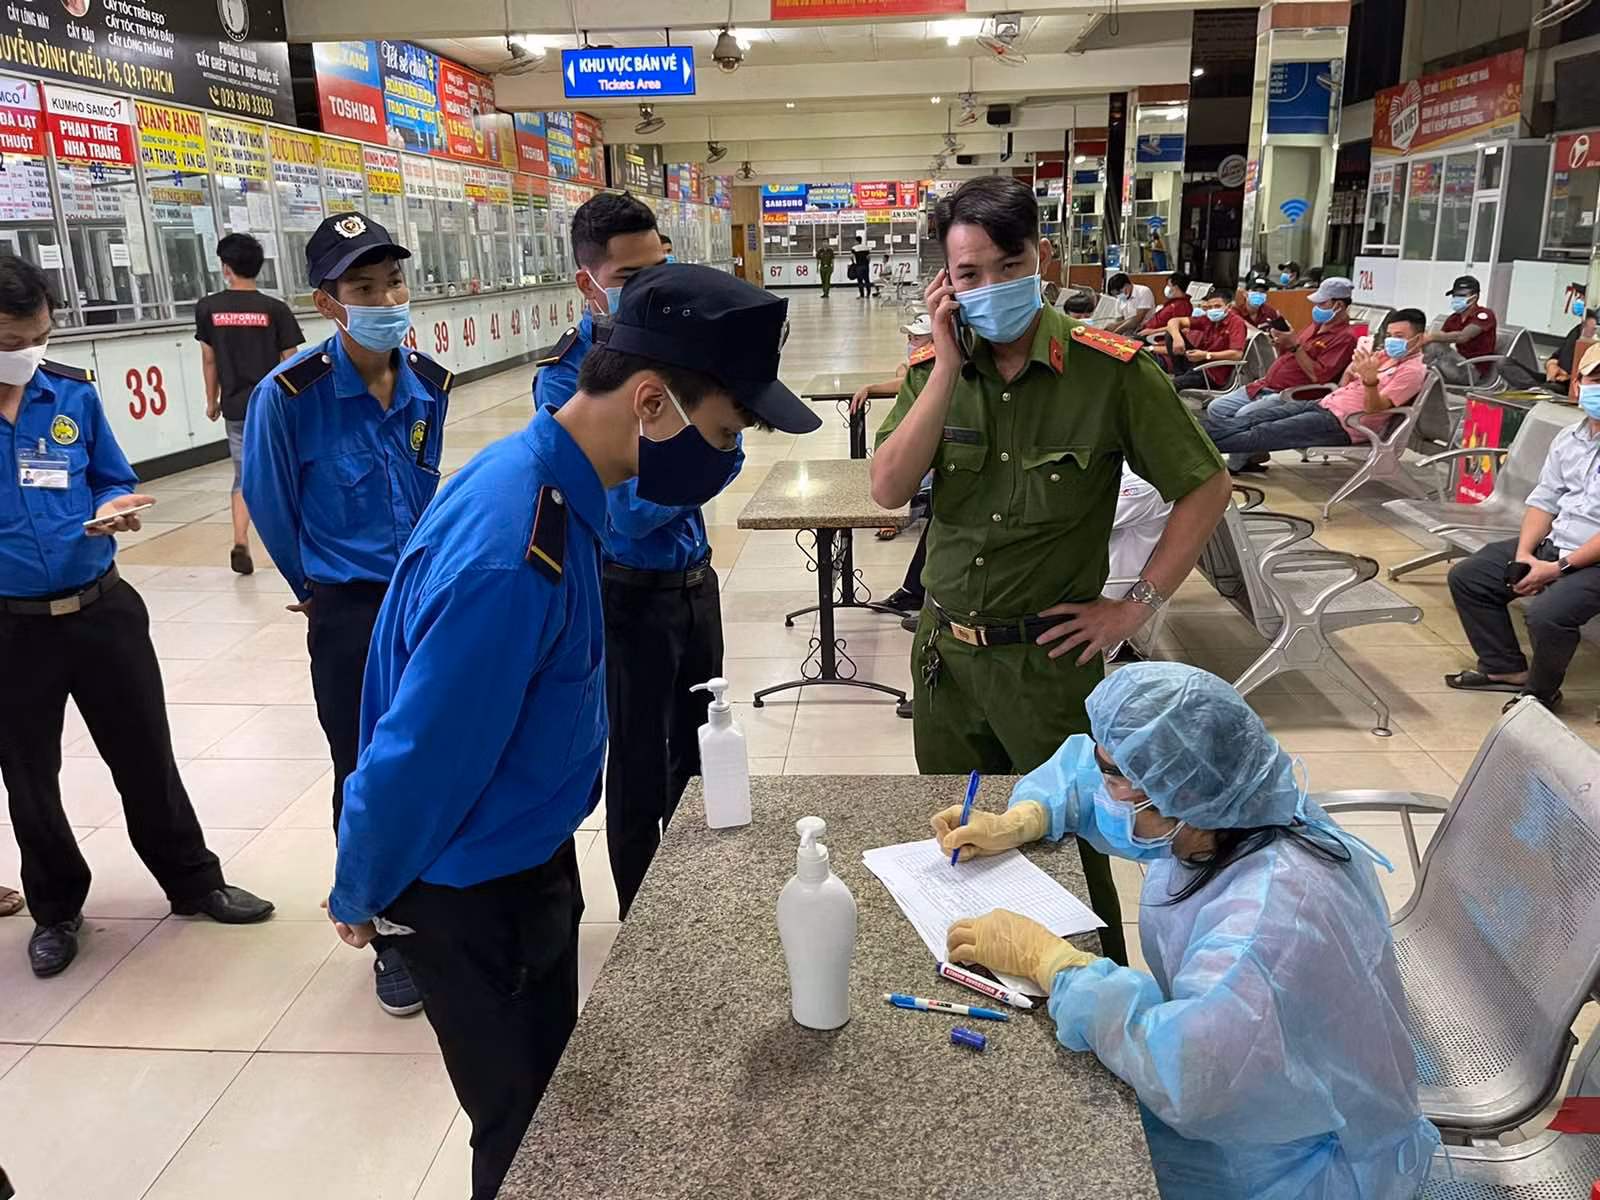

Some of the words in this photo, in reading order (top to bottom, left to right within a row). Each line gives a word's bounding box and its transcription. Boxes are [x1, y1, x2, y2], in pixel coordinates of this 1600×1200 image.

[105, 14, 121, 29] CẤY
[120, 18, 136, 33] TÓC
[108, 32, 122, 47] CẤY
[0, 28, 39, 67] UYỄN
[37, 38, 69, 73] ĐÌNH
[106, 58, 123, 87] P6,
[123, 62, 141, 90] Q3,
[140, 66, 175, 95] TP.HCM
[578, 57, 606, 73] KHU
[605, 55, 634, 76] VỰC
[633, 53, 661, 72] BÁN
[660, 53, 678, 71] VÉ
[598, 78, 635, 91] Tickets
[636, 78, 662, 90] Area
[51, 97, 85, 114] KUMHO
[85, 102, 116, 118] SAMCO
[328, 95, 379, 126] TOSHIBA
[16, 114, 37, 132] LẠT
[59, 119, 91, 139] PHAN
[90, 122, 119, 143] THIẾT
[171, 110, 202, 139] HẠNH
[63, 139, 88, 158] NHA
[88, 143, 122, 161] TRANG
[154, 148, 178, 167] TRANG
[521, 145, 545, 163] TOSHIBA
[764, 198, 804, 208] SAMSUNG
[770, 265, 783, 277] 67
[796, 265, 809, 277] 68
[899, 262, 911, 274] 72
[213, 313, 268, 321] CALIFORNIA
[511, 308, 521, 335] 42
[531, 304, 541, 331] 43
[549, 303, 558, 327] 44
[434, 321, 449, 354] 39
[463, 317, 476, 347] 40
[490, 313, 501, 341] 41
[126, 365, 167, 421] 33
